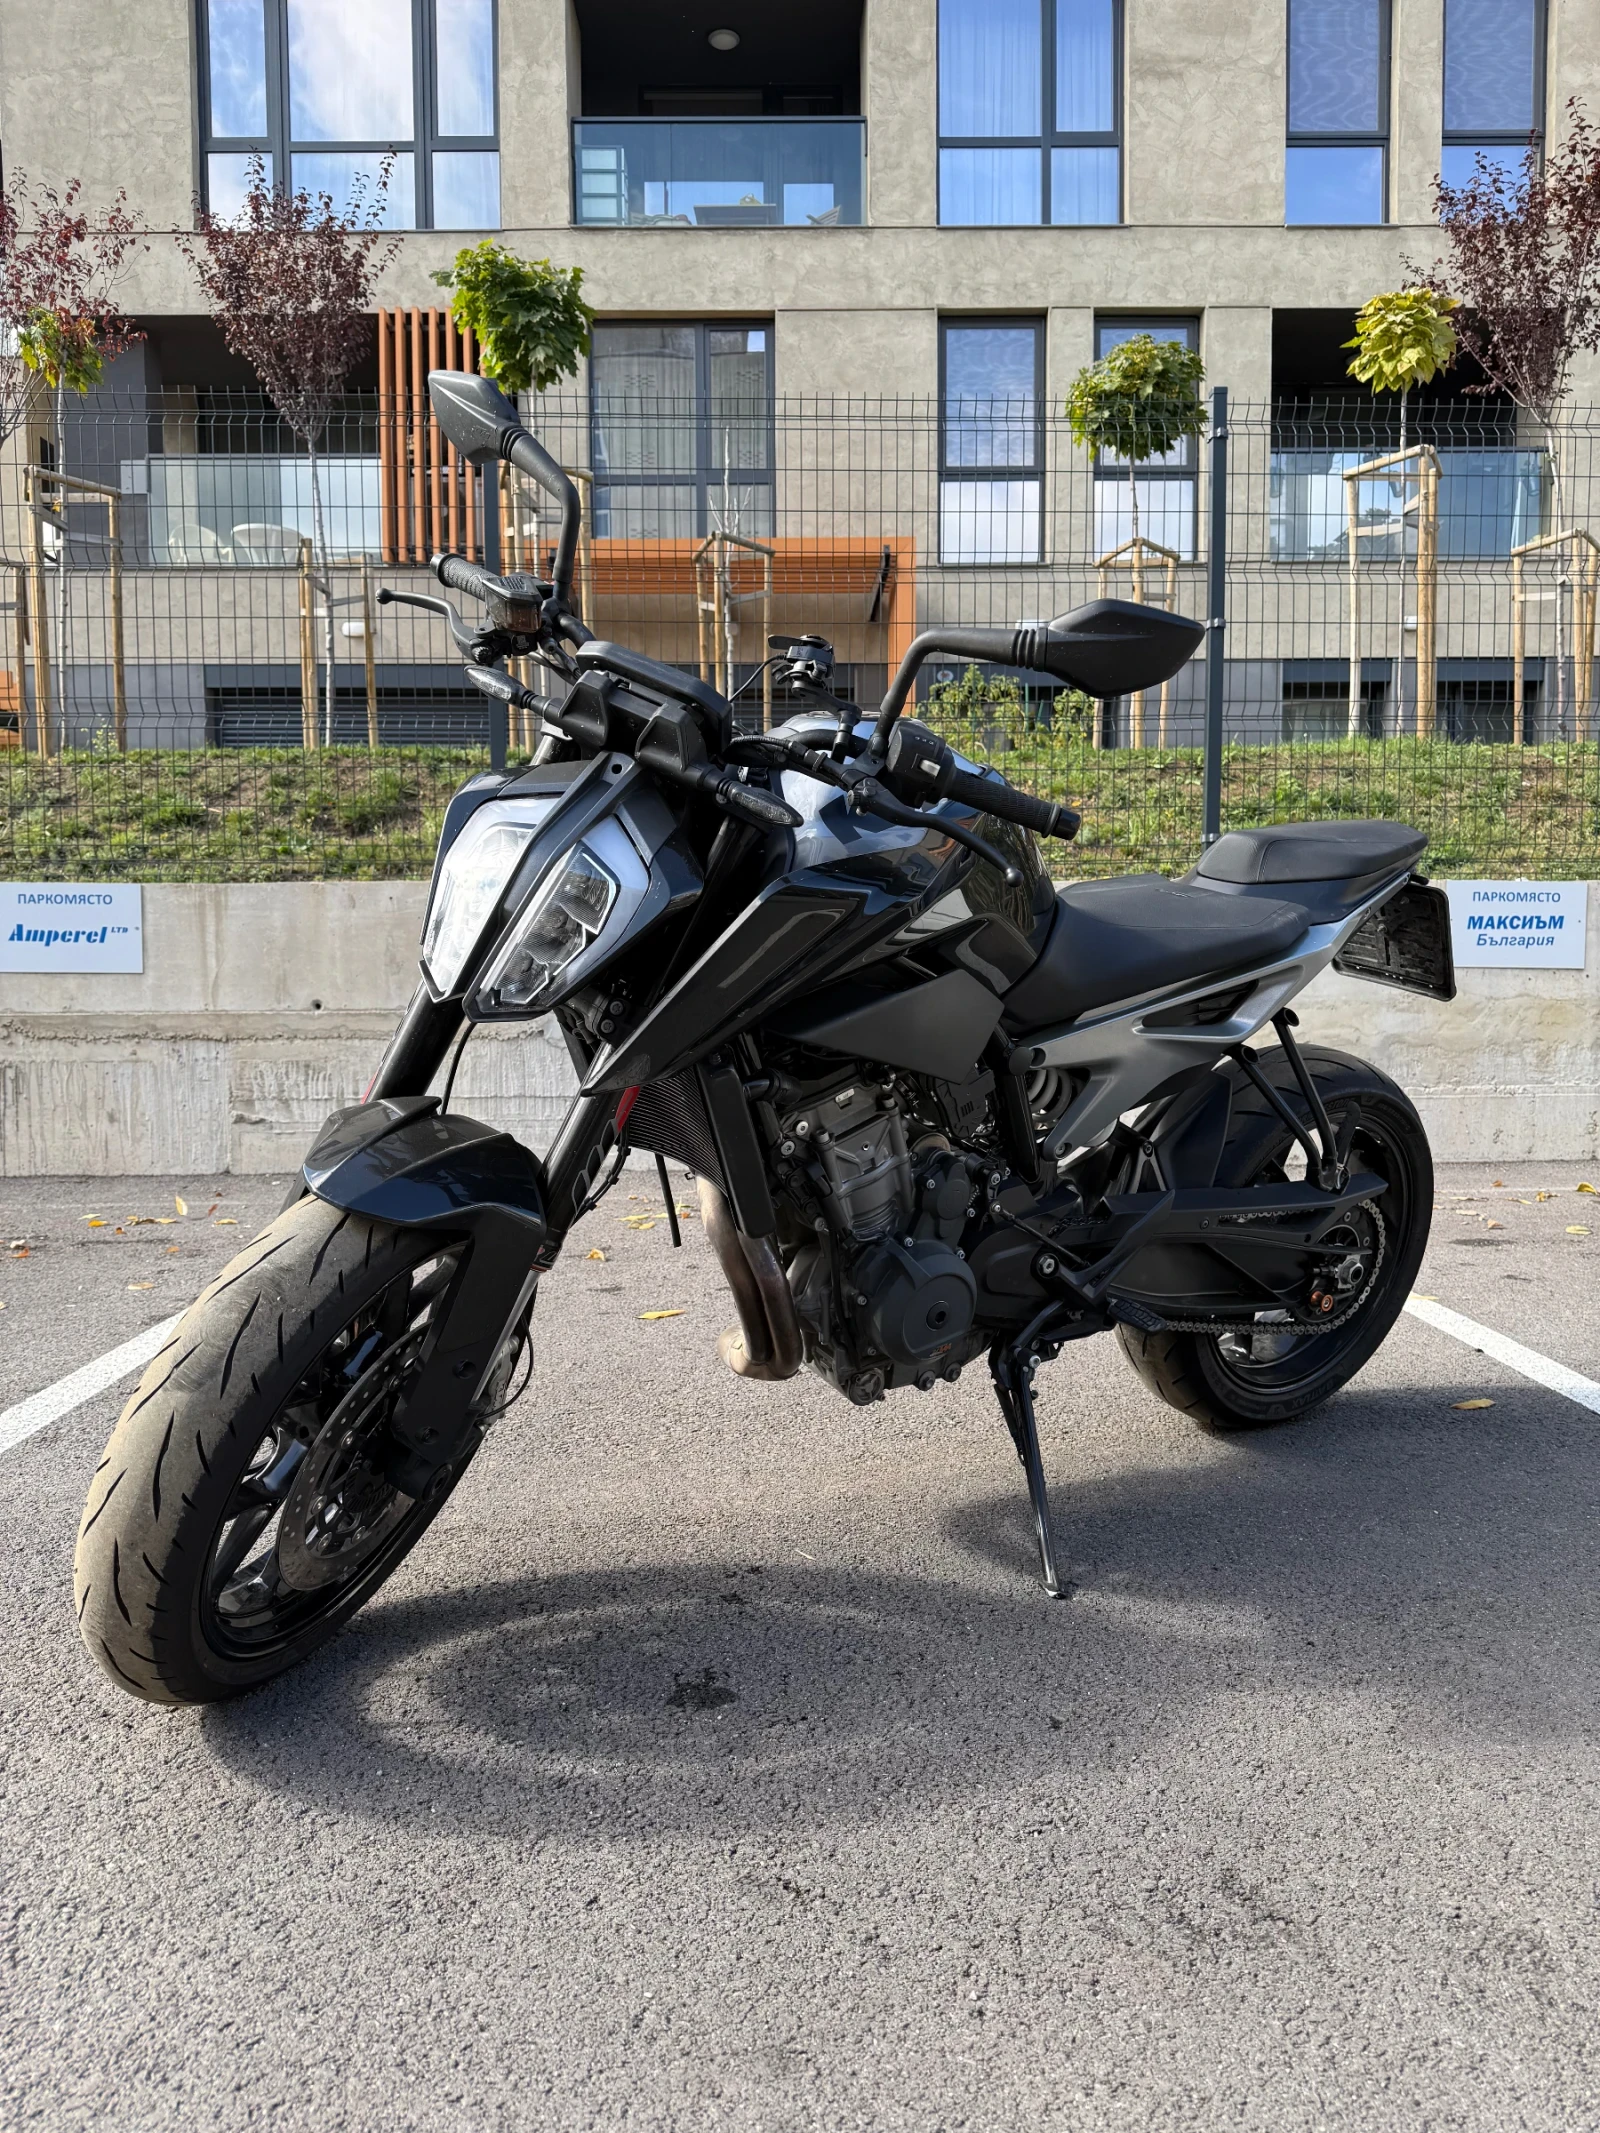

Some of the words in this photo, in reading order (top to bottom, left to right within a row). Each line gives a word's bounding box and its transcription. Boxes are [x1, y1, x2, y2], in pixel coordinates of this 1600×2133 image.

[17, 893, 113, 905] ПАРКОМЯСТО
[1472, 891, 1561, 903] ПАРКОМЯСТО
[1467, 915, 1565, 930] МАКСИЪМ
[8, 923, 108, 947] Amperel
[1476, 933, 1555, 949] България
